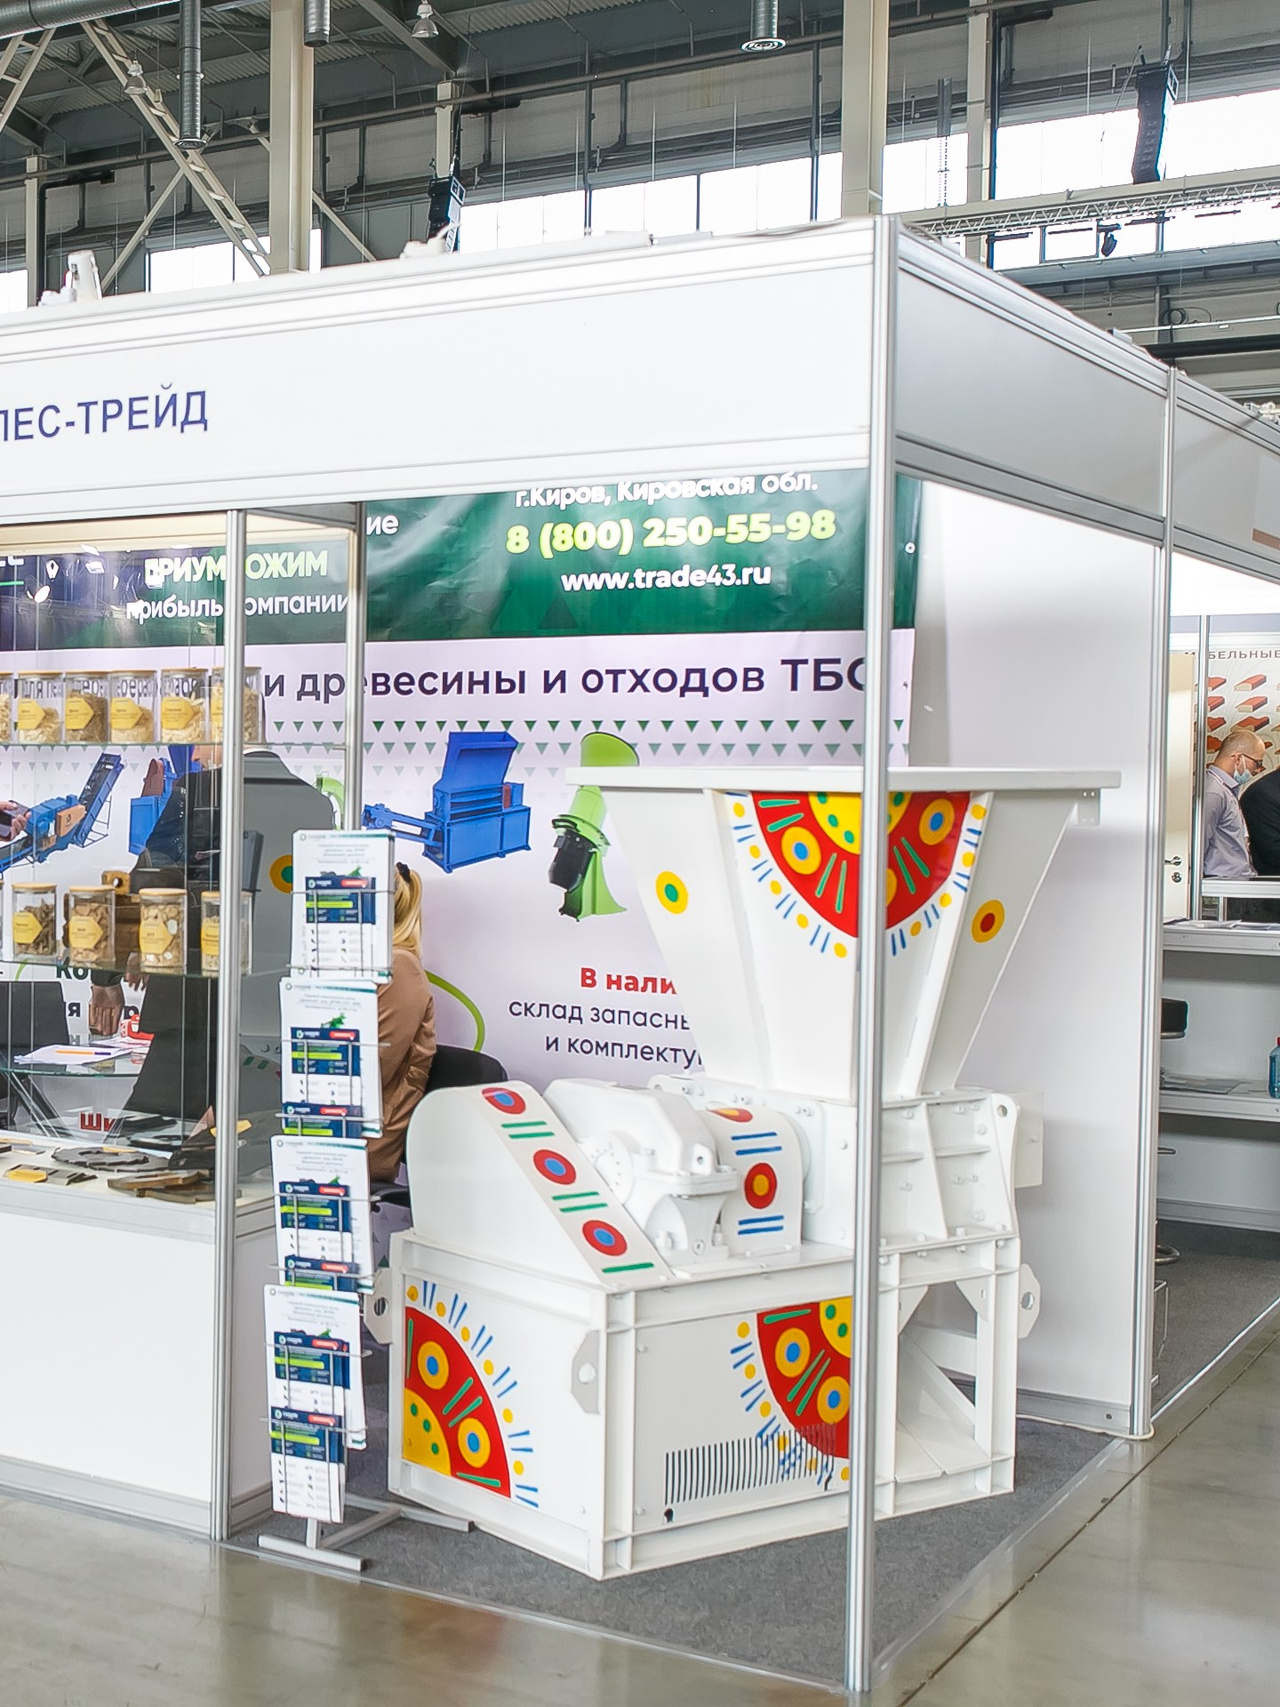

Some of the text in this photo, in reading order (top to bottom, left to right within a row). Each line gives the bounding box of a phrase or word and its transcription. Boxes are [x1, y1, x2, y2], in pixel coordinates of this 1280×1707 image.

[617, 476, 756, 505] Кировская
[761, 471, 819, 493] обл.
[505, 508, 837, 559] 8 (800) 250-55-98
[561, 563, 772, 592] www.trade43.ru
[245, 594, 350, 616] омпании
[296, 670, 527, 704] дрвесины
[543, 669, 567, 694] и
[581, 667, 765, 698] отходов
[580, 967, 597, 988] В
[508, 1000, 583, 1025] склад
[545, 1035, 559, 1052] и
